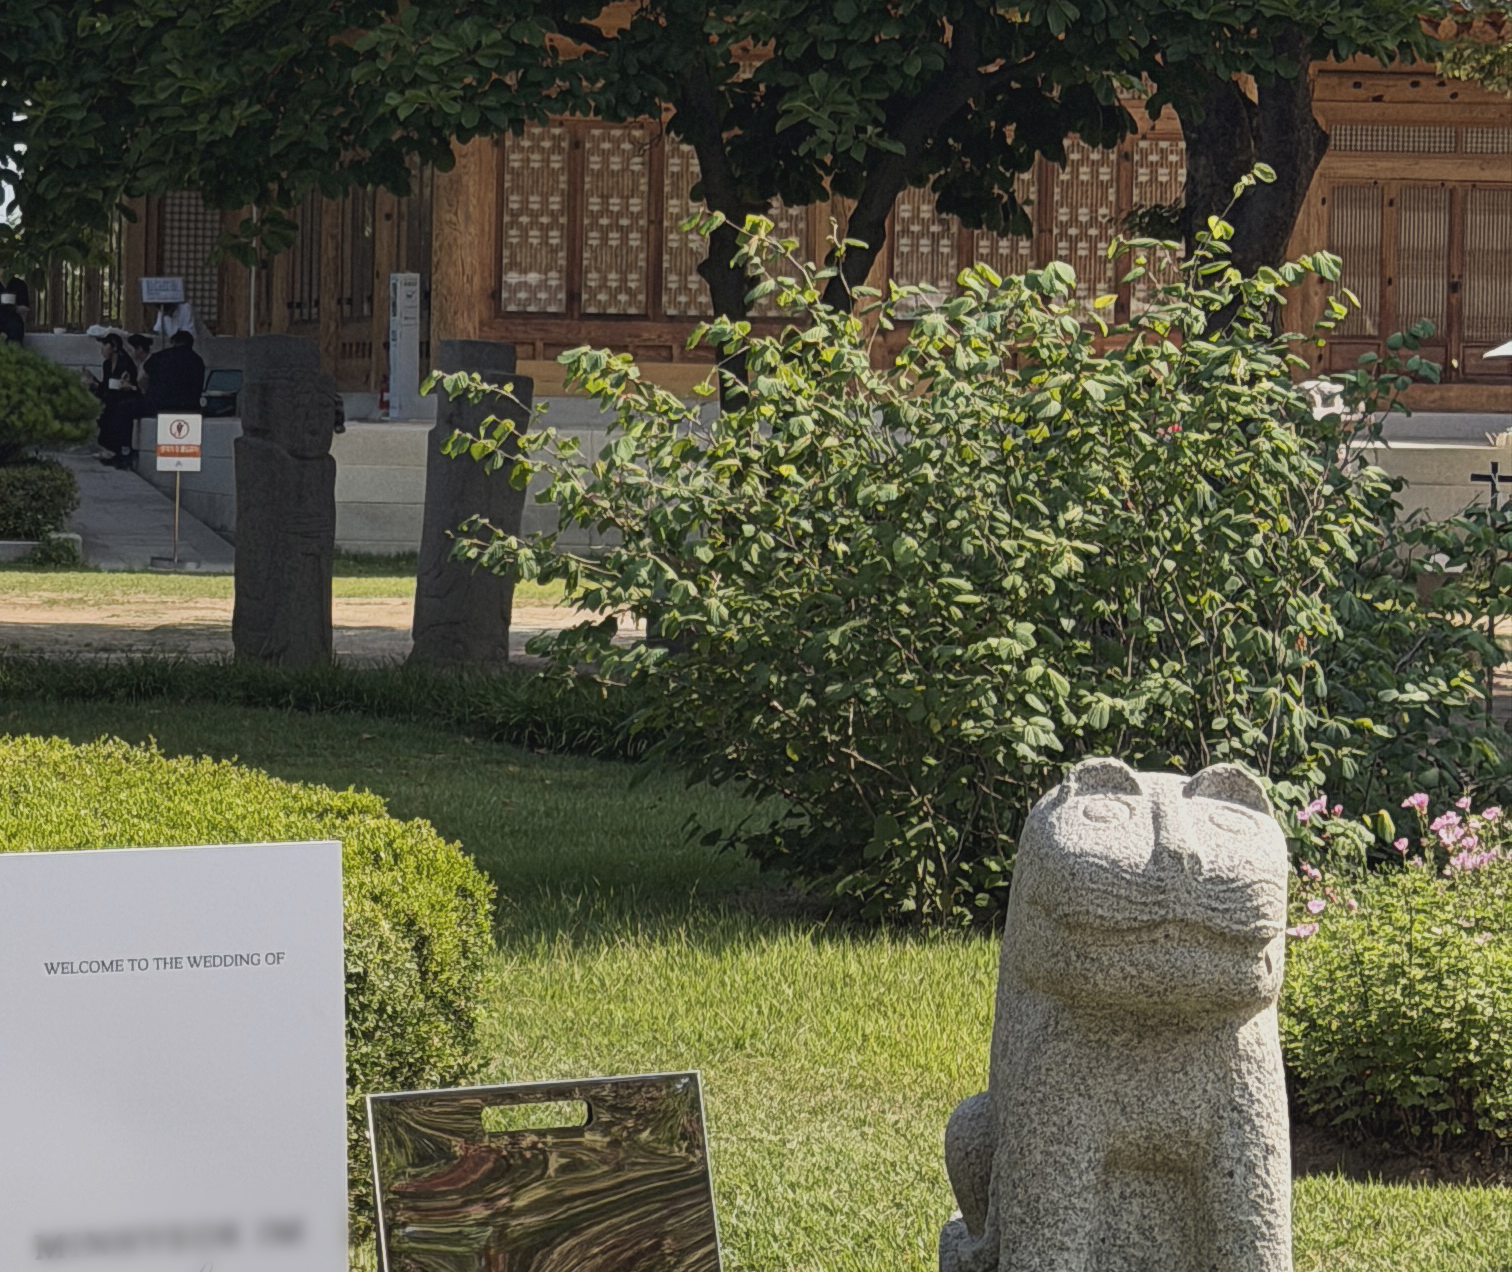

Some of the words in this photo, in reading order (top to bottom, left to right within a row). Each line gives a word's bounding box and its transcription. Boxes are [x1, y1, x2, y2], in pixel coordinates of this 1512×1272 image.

[43, 958, 125, 975] WELCOME
[127, 958, 149, 972] TO
[152, 956, 184, 971] THE
[186, 953, 262, 969] WEDDING
[264, 952, 286, 965] OF
